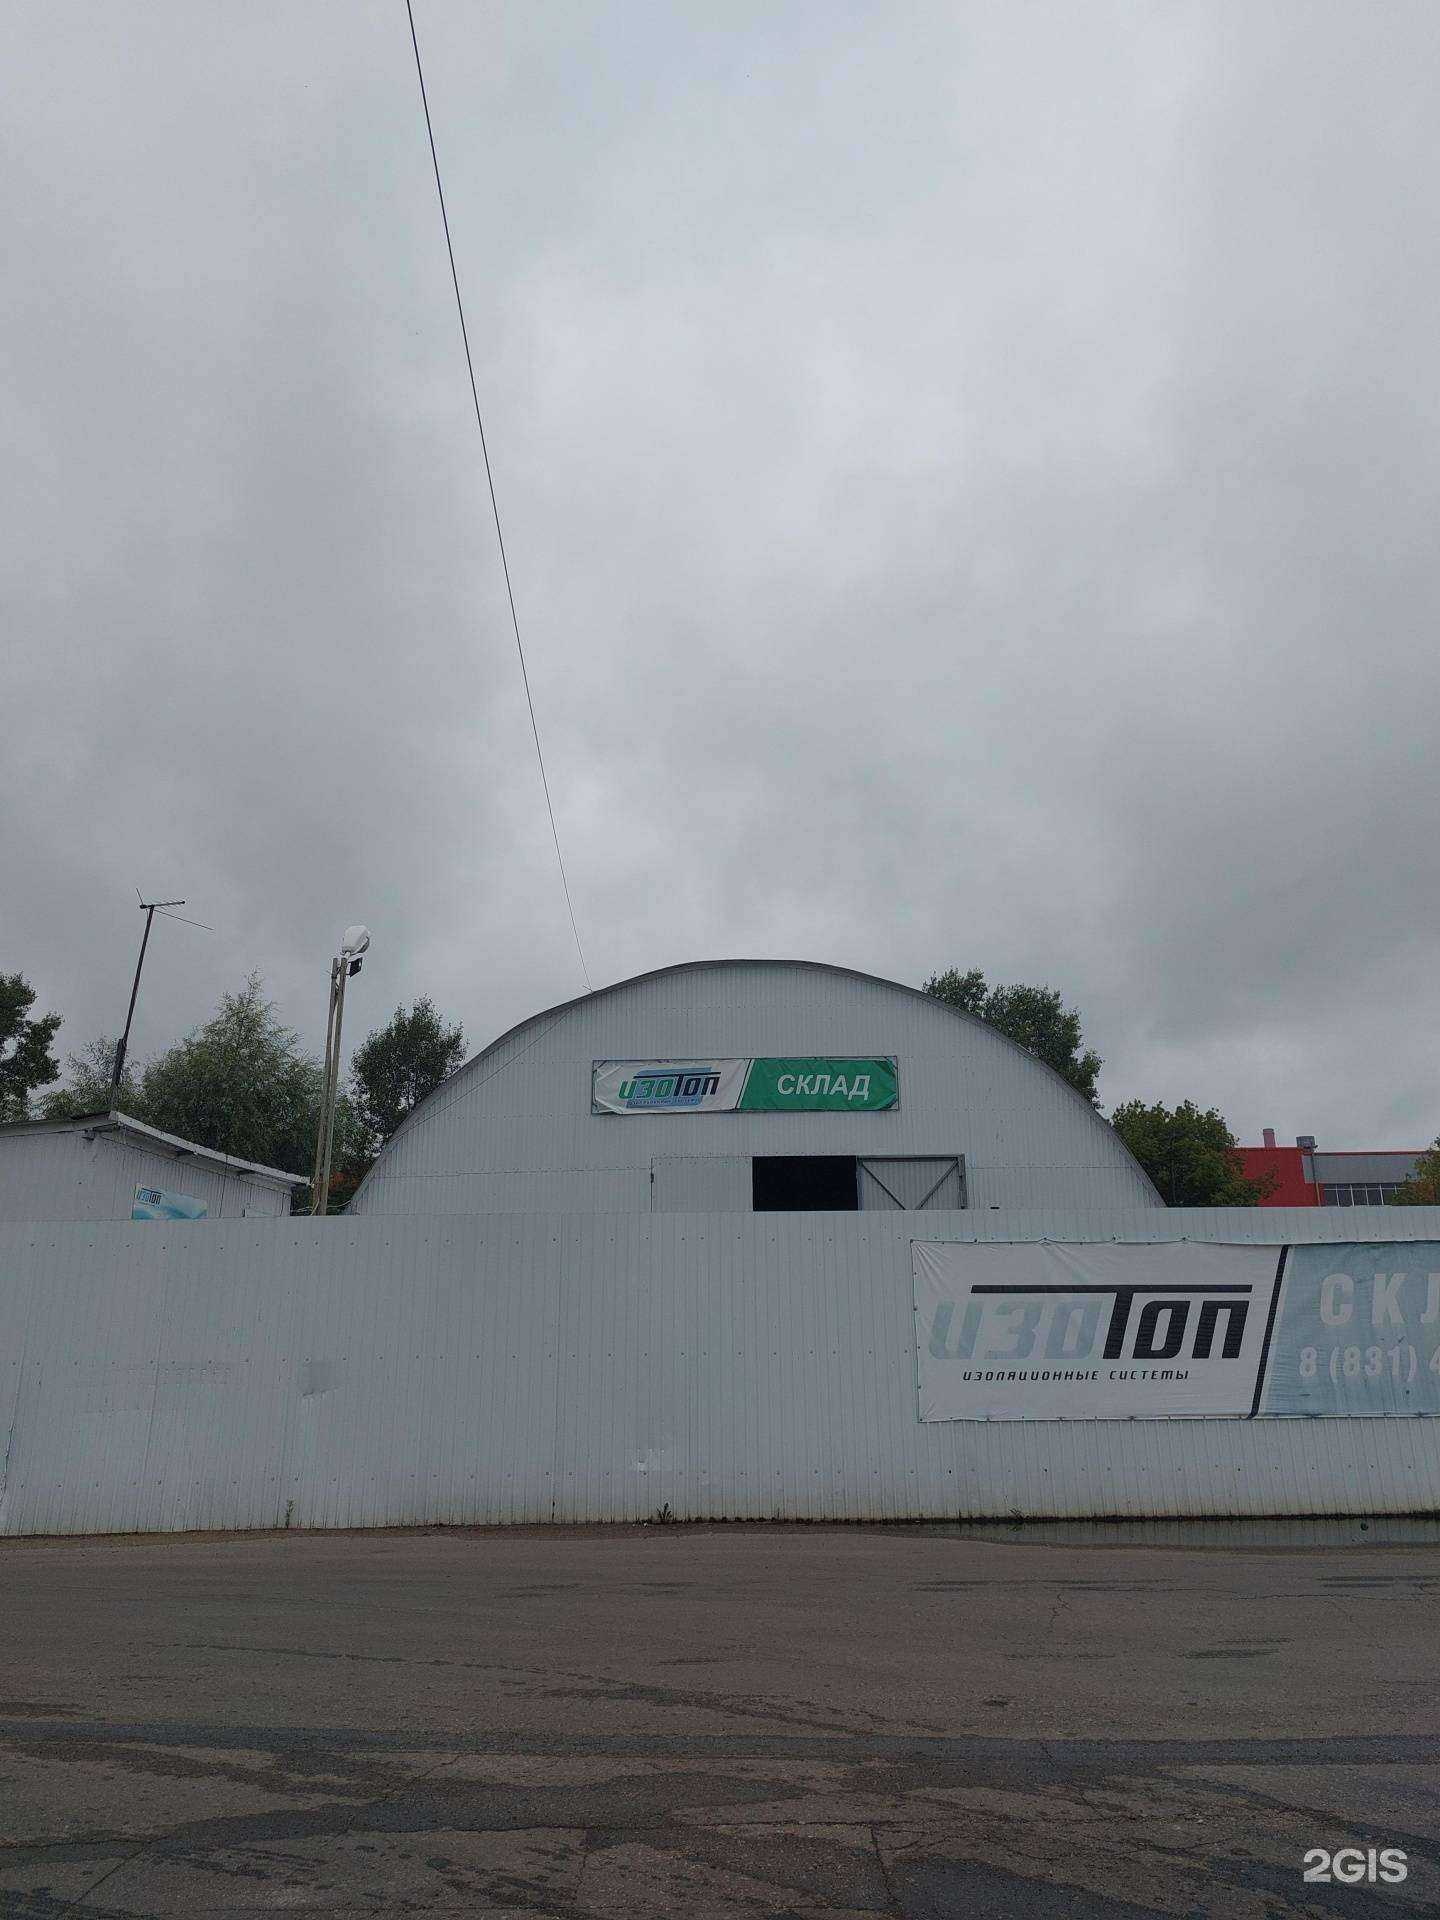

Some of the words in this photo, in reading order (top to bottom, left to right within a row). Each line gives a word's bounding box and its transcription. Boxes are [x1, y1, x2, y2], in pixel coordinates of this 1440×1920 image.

[776, 1074, 871, 1101] СКЛАД
[1299, 1346, 1318, 1377] 8
[1329, 1345, 1417, 1384] (831)
